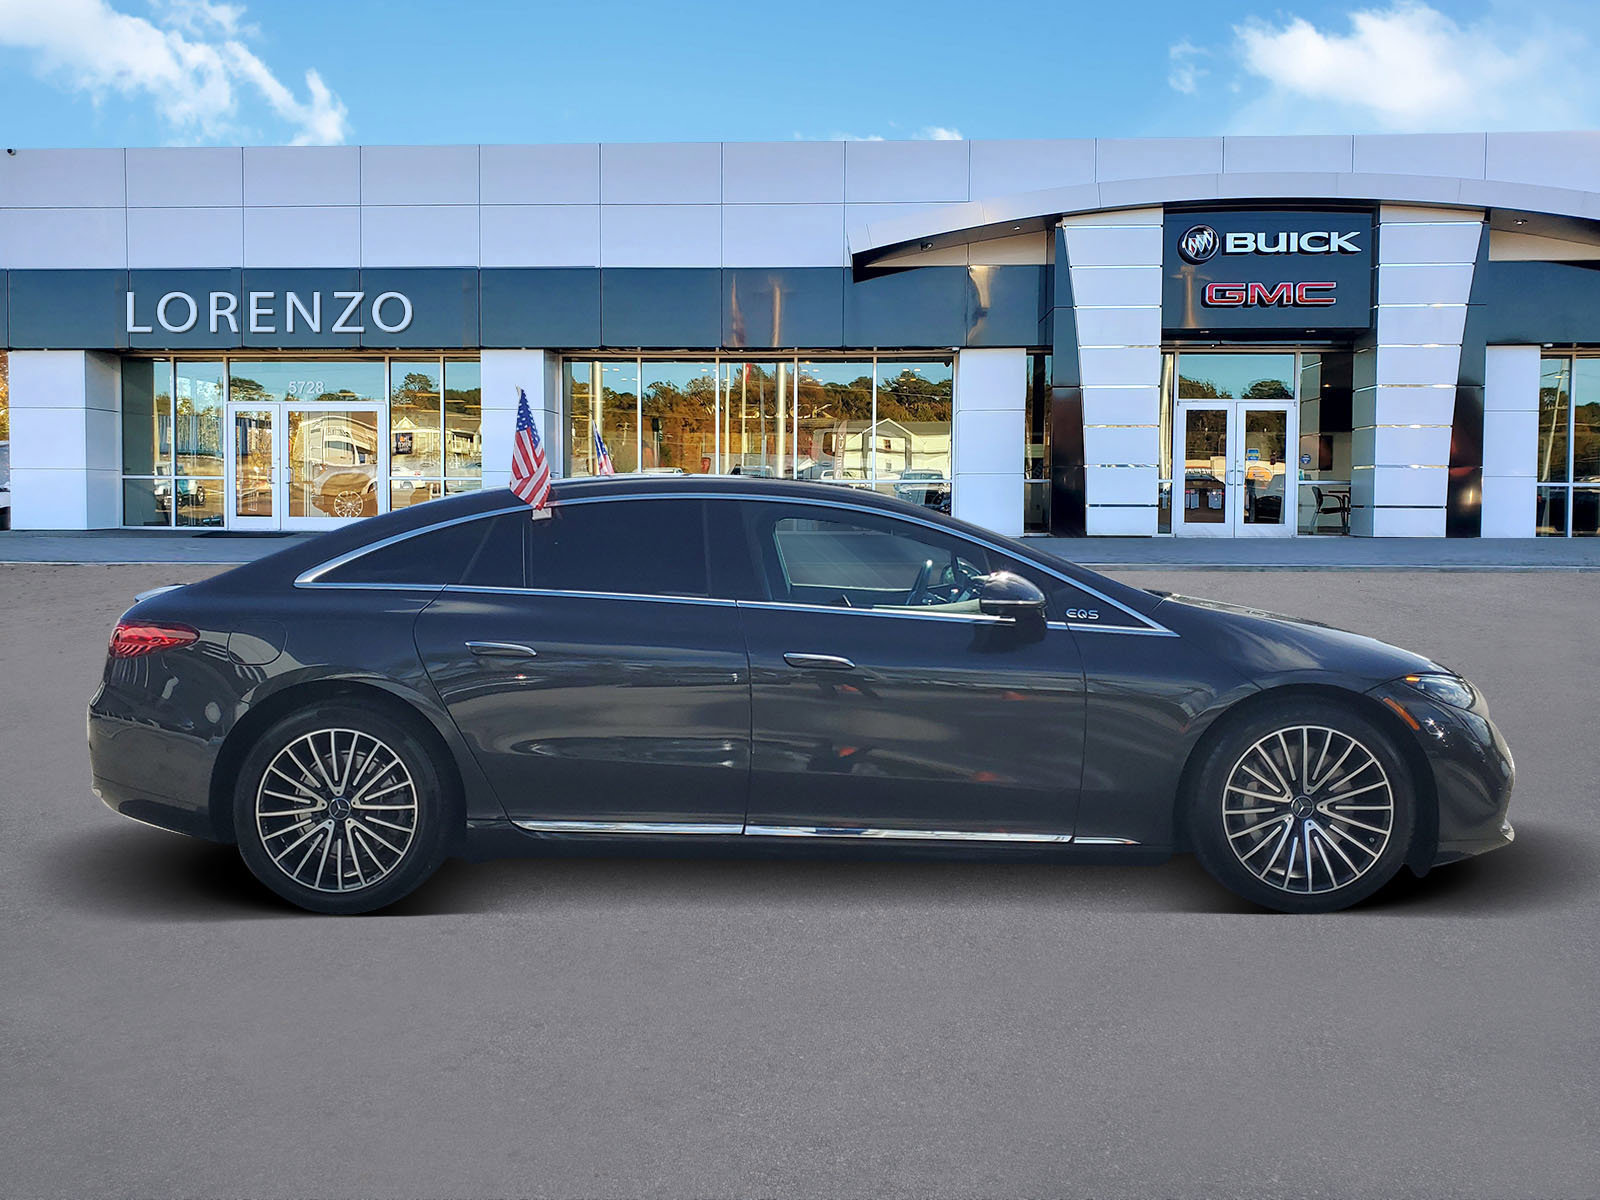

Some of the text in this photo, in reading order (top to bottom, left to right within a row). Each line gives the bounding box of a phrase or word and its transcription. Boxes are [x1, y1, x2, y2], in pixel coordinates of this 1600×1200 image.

[1225, 231, 1362, 254] BUICK
[1204, 281, 1337, 306] GMC
[126, 291, 414, 334] LORENZO
[288, 380, 325, 394] 5728
[1065, 608, 1100, 620] EQS
